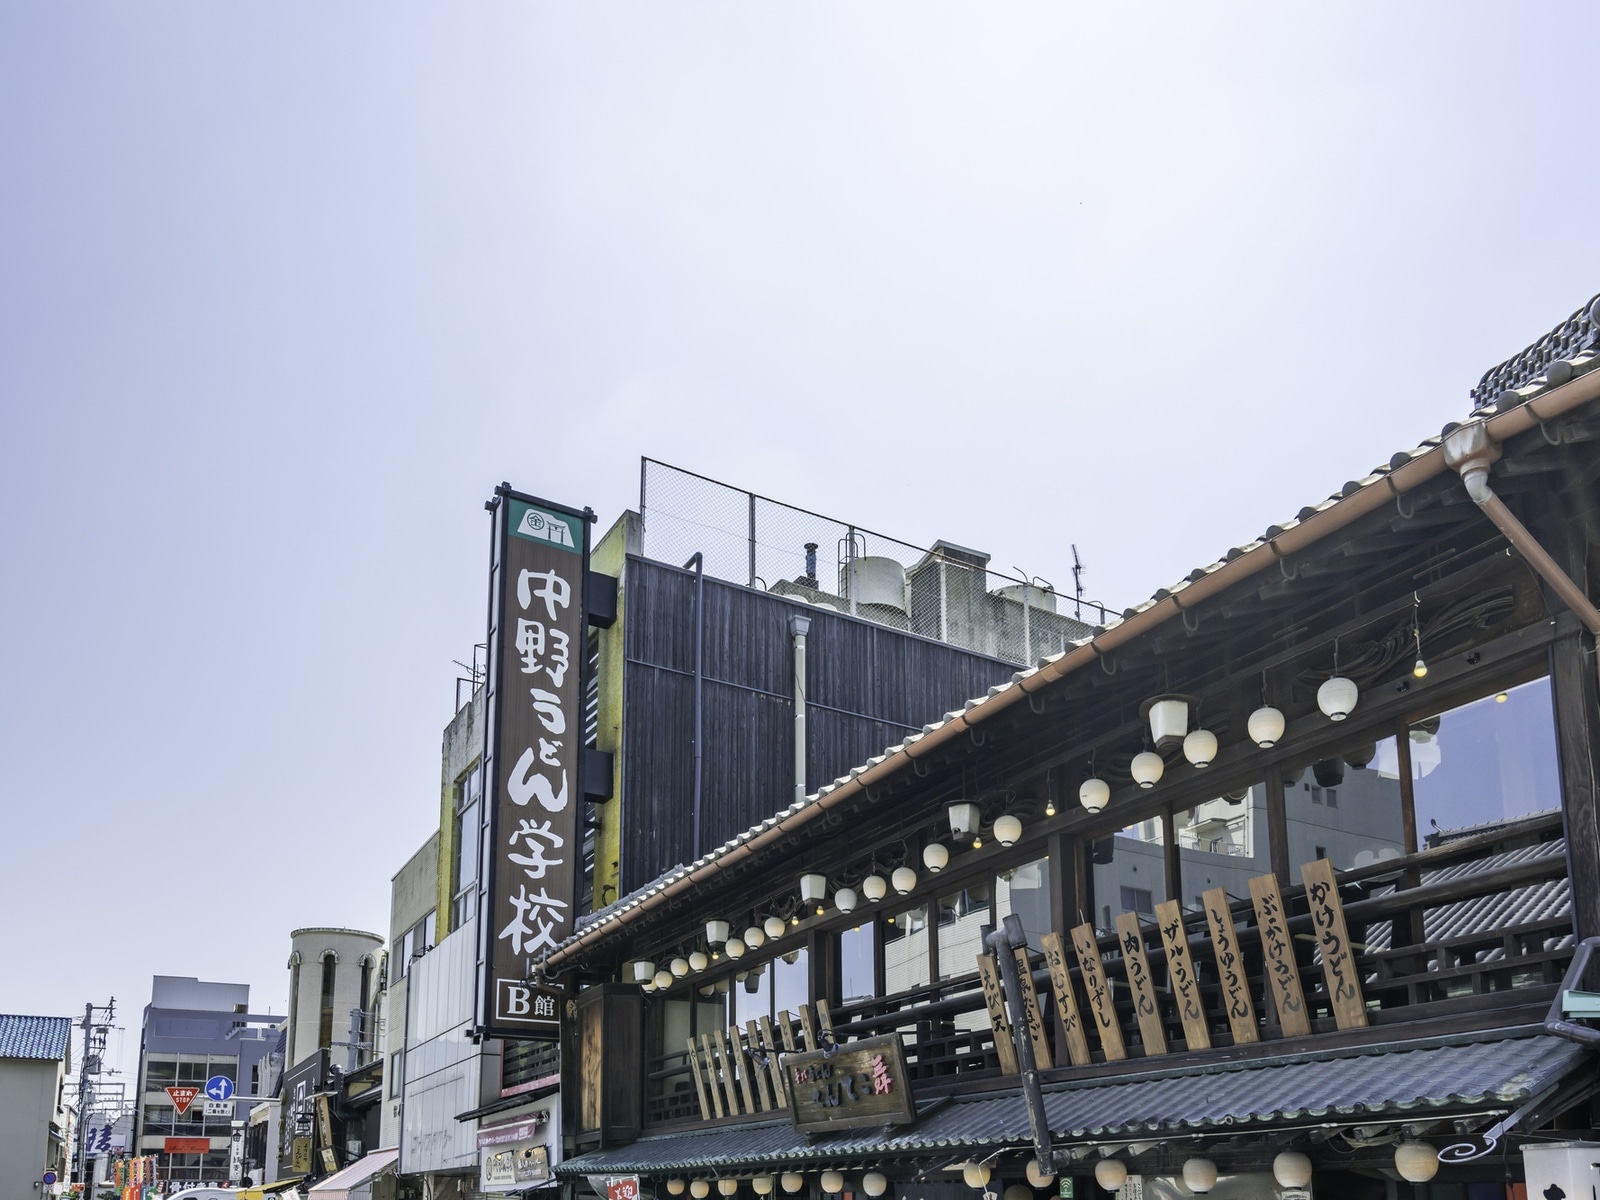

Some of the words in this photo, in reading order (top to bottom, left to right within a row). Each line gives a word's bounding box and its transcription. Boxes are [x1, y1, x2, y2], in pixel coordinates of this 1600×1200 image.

[499, 568, 571, 955] 中野うどん学校
[1047, 950, 1076, 1032] おむすび
[1077, 941, 1110, 1027] いなりずし
[1123, 931, 1154, 1017] 肉うどん
[1163, 918, 1199, 1020] ザルうどん
[1211, 909, 1248, 1019] しょうゆうどん
[1258, 894, 1300, 1015] ぶっかけうどん
[1310, 881, 1355, 1003] かけうどん
[984, 968, 1006, 1033] えび天
